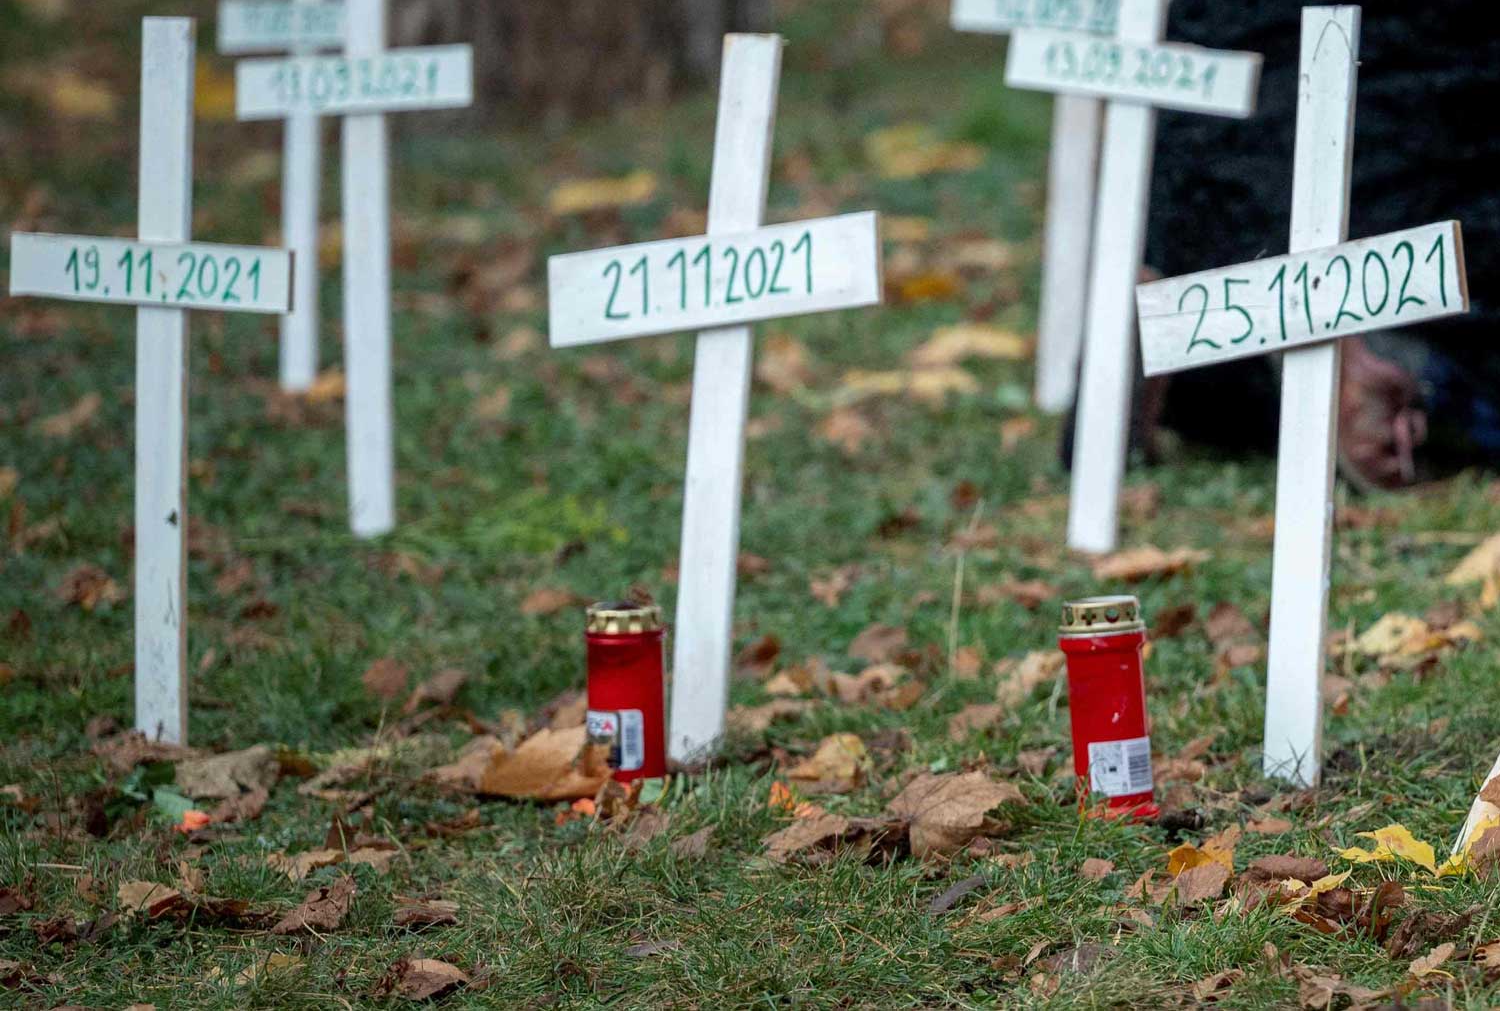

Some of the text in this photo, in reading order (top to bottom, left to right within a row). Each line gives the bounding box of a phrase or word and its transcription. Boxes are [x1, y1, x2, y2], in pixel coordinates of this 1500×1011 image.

[64, 245, 261, 305] 19.11.2021
[602, 229, 813, 321] 21.11.2021
[1177, 233, 1449, 355] 25.11.2021
